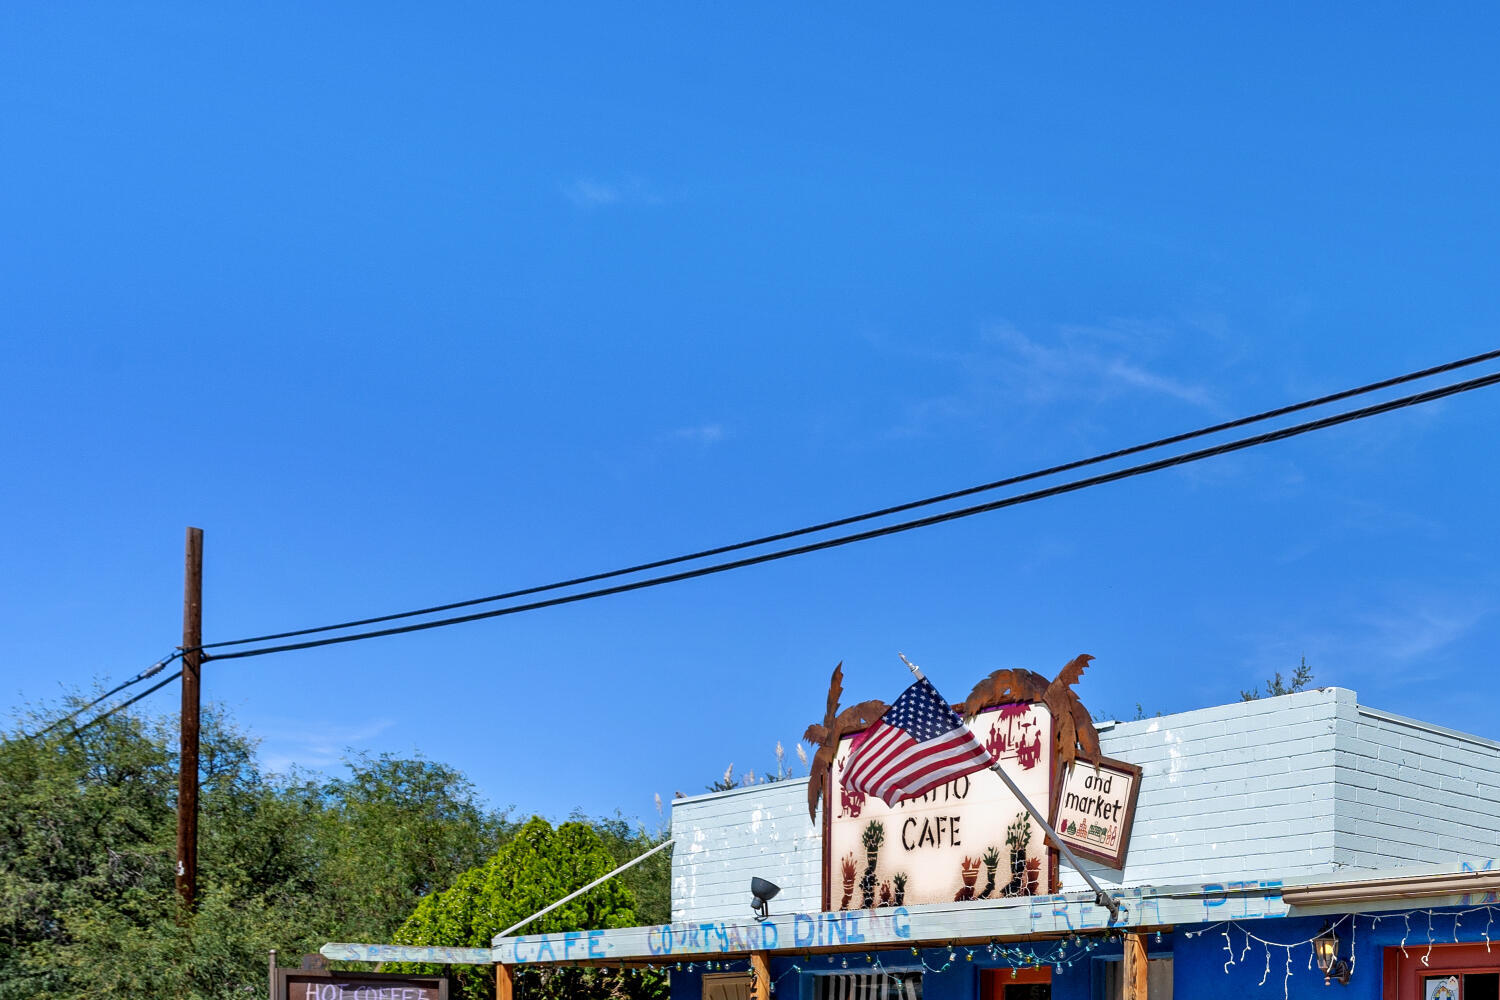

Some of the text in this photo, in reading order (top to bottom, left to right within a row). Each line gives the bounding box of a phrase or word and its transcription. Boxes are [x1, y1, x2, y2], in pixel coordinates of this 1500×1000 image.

[1085, 776, 1113, 795] and
[1065, 792, 1122, 823] market
[902, 816, 961, 851] CAFE
[514, 930, 605, 963] CAFE
[648, 907, 911, 954] COURTYARD DINING
